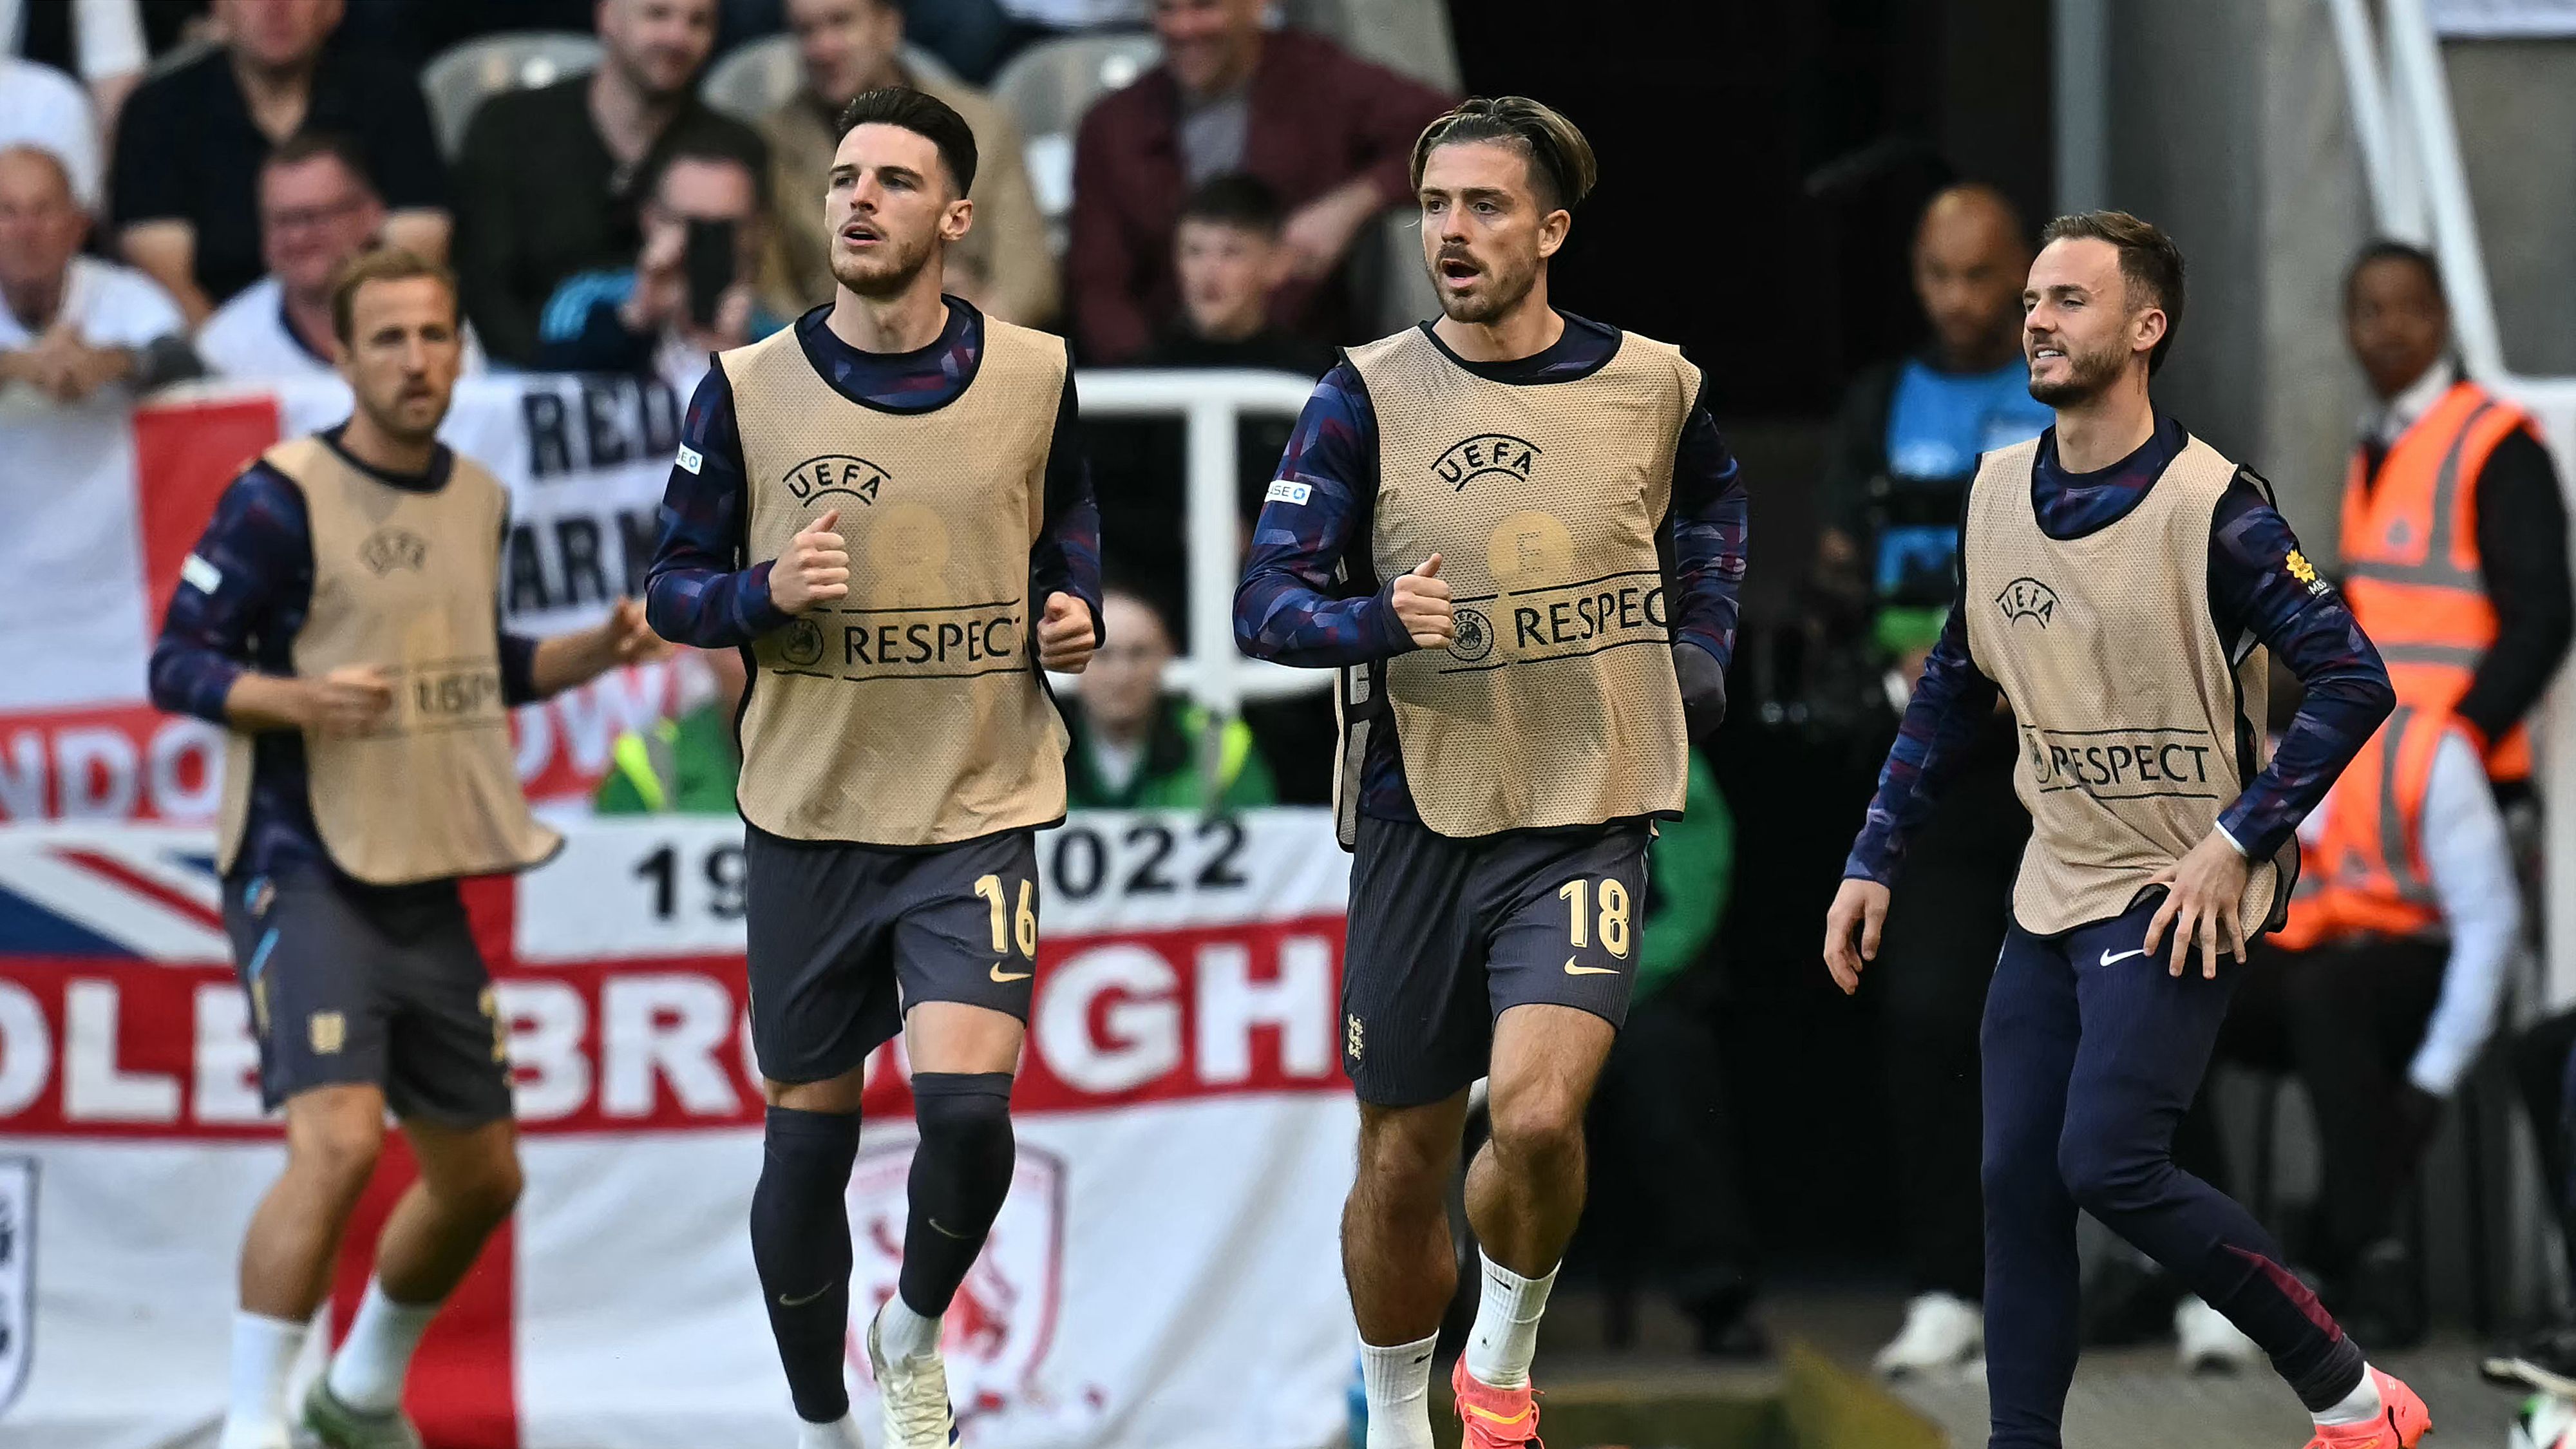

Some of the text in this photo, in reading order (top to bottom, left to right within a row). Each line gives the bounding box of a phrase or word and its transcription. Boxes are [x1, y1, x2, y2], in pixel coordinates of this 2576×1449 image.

[789, 463, 881, 499] UEFA
[1438, 442, 1531, 484] UEFA
[2001, 585, 2055, 623] UEFA
[844, 616, 1025, 665] RESPEC
[2050, 743, 2209, 784] RESPECT
[975, 874, 1036, 961] 16
[1559, 878, 1631, 960] 18
